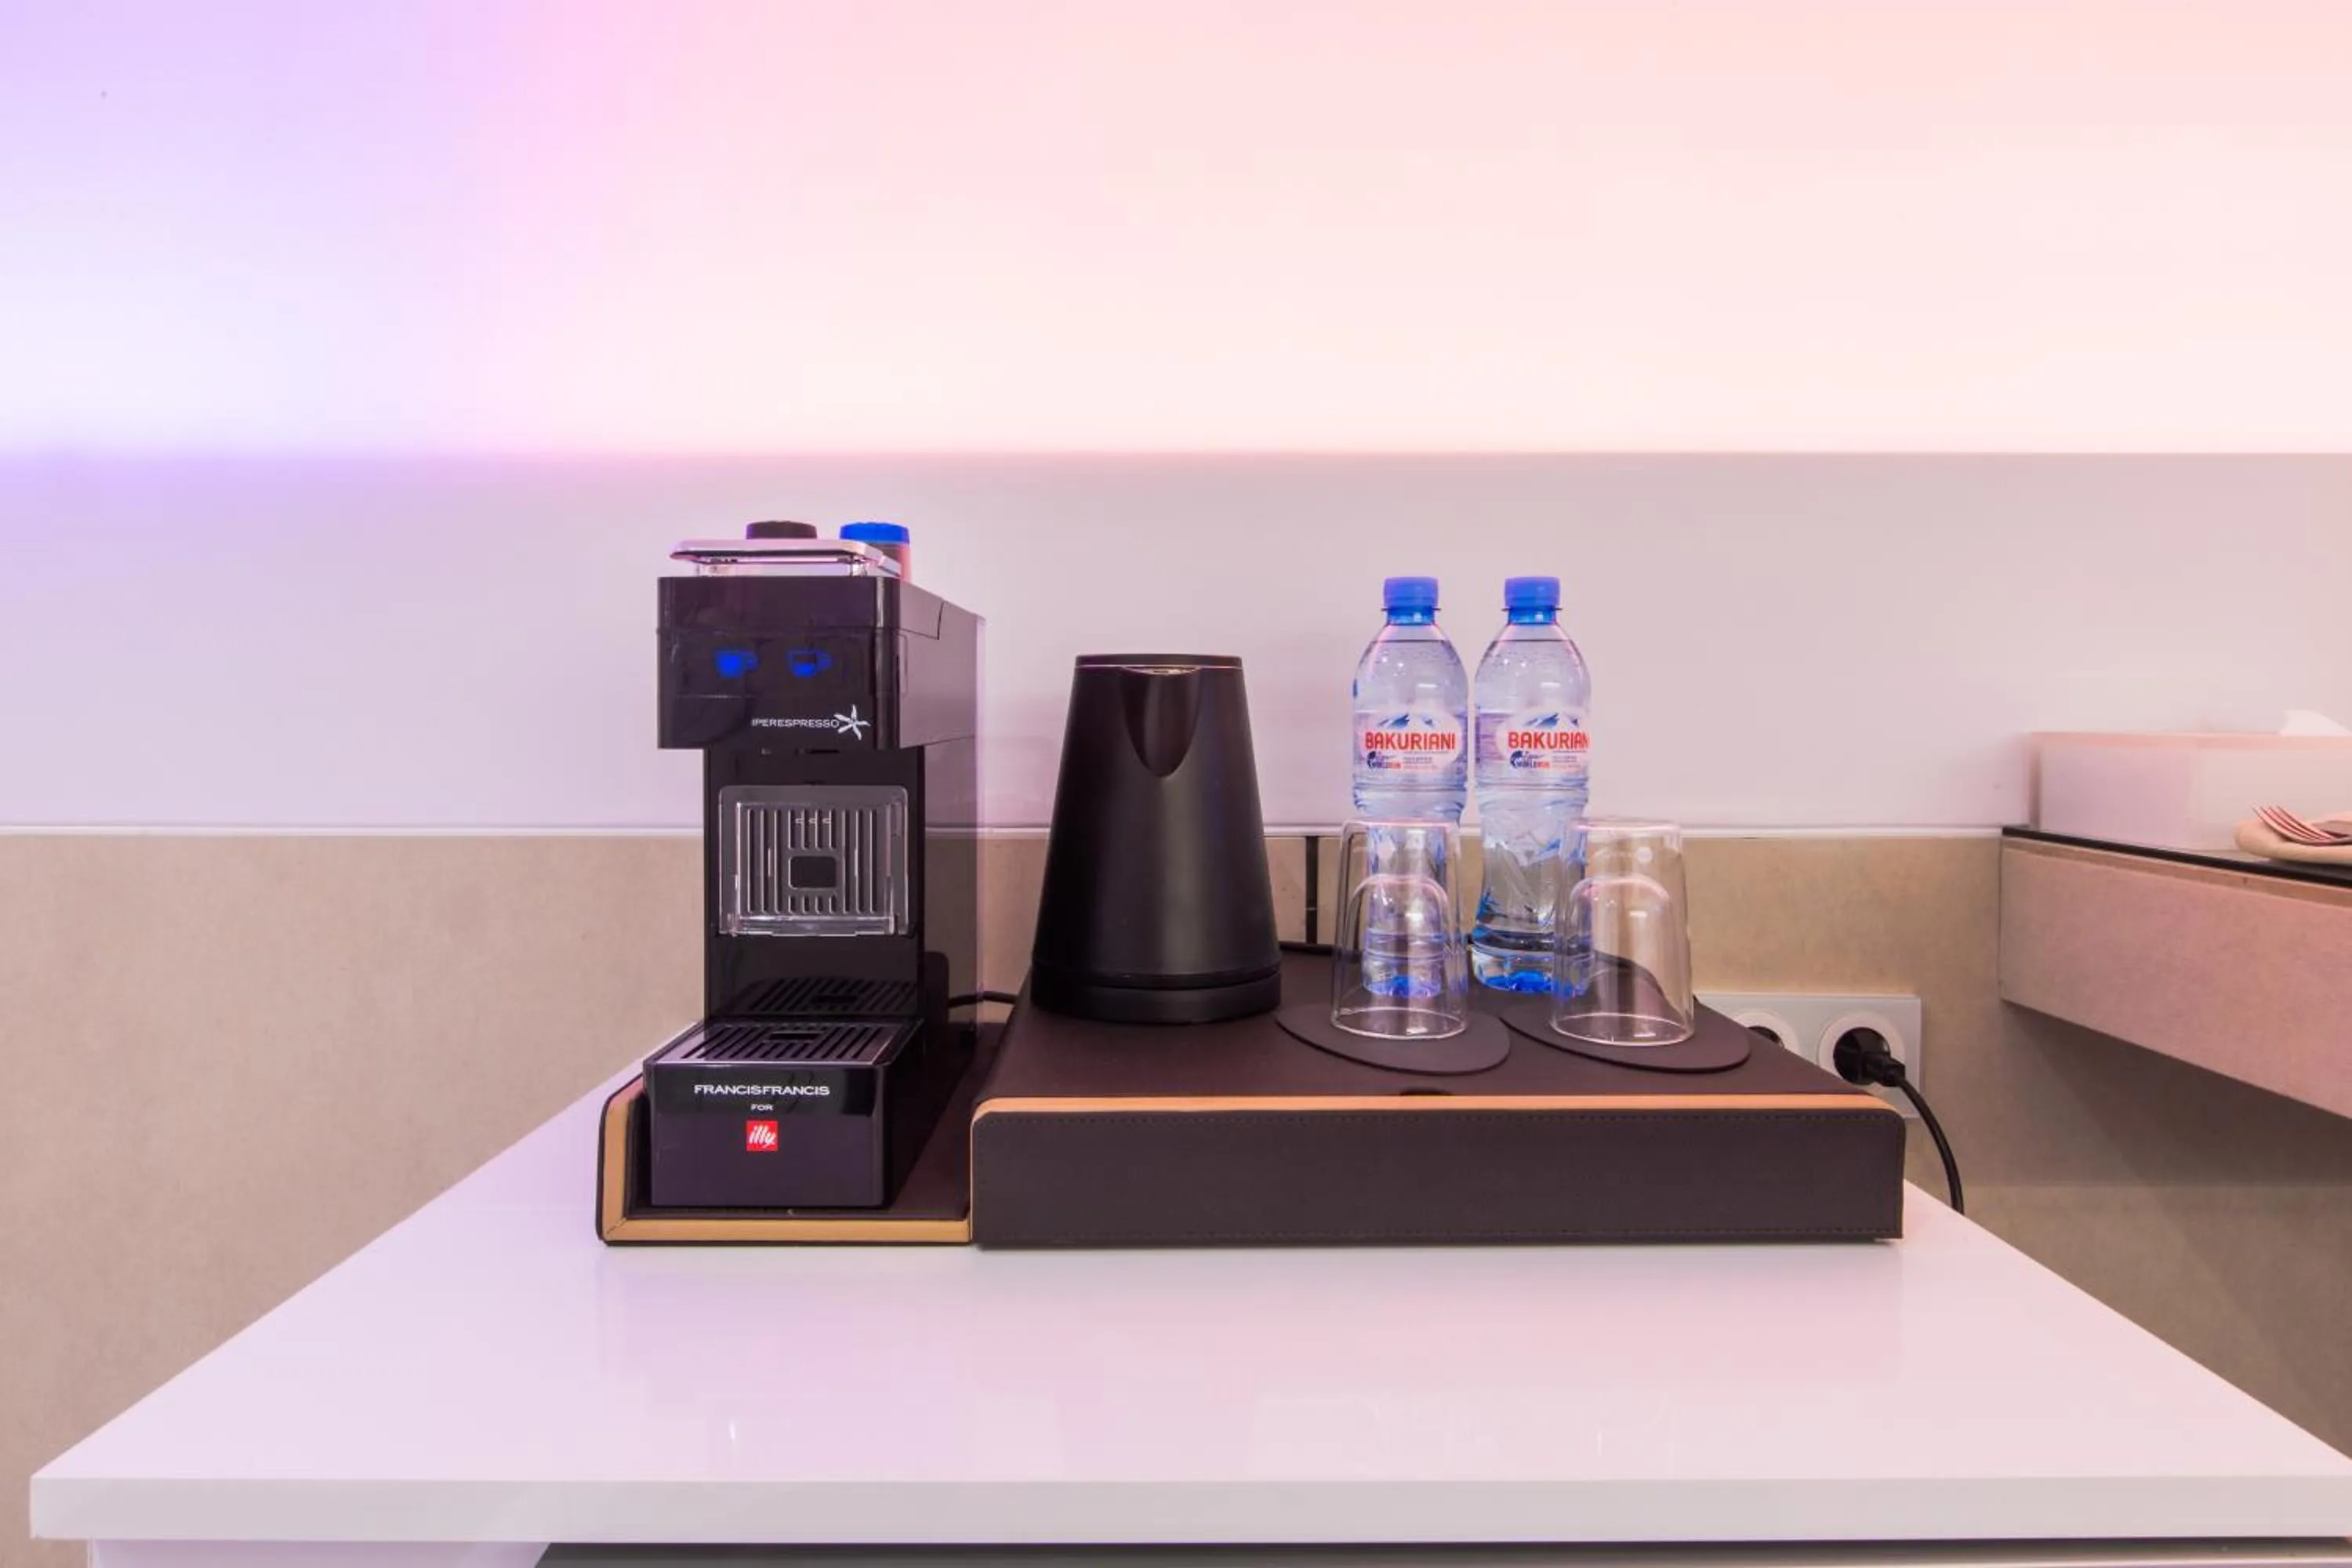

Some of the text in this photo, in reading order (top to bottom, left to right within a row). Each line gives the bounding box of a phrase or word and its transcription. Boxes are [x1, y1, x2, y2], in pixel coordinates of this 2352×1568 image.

[751, 718, 840, 728] IPERESPRESSO
[1365, 731, 1456, 750] BAKURIANI
[693, 1084, 830, 1095] FRANCISFRANCIS
[748, 1124, 777, 1149] illy
